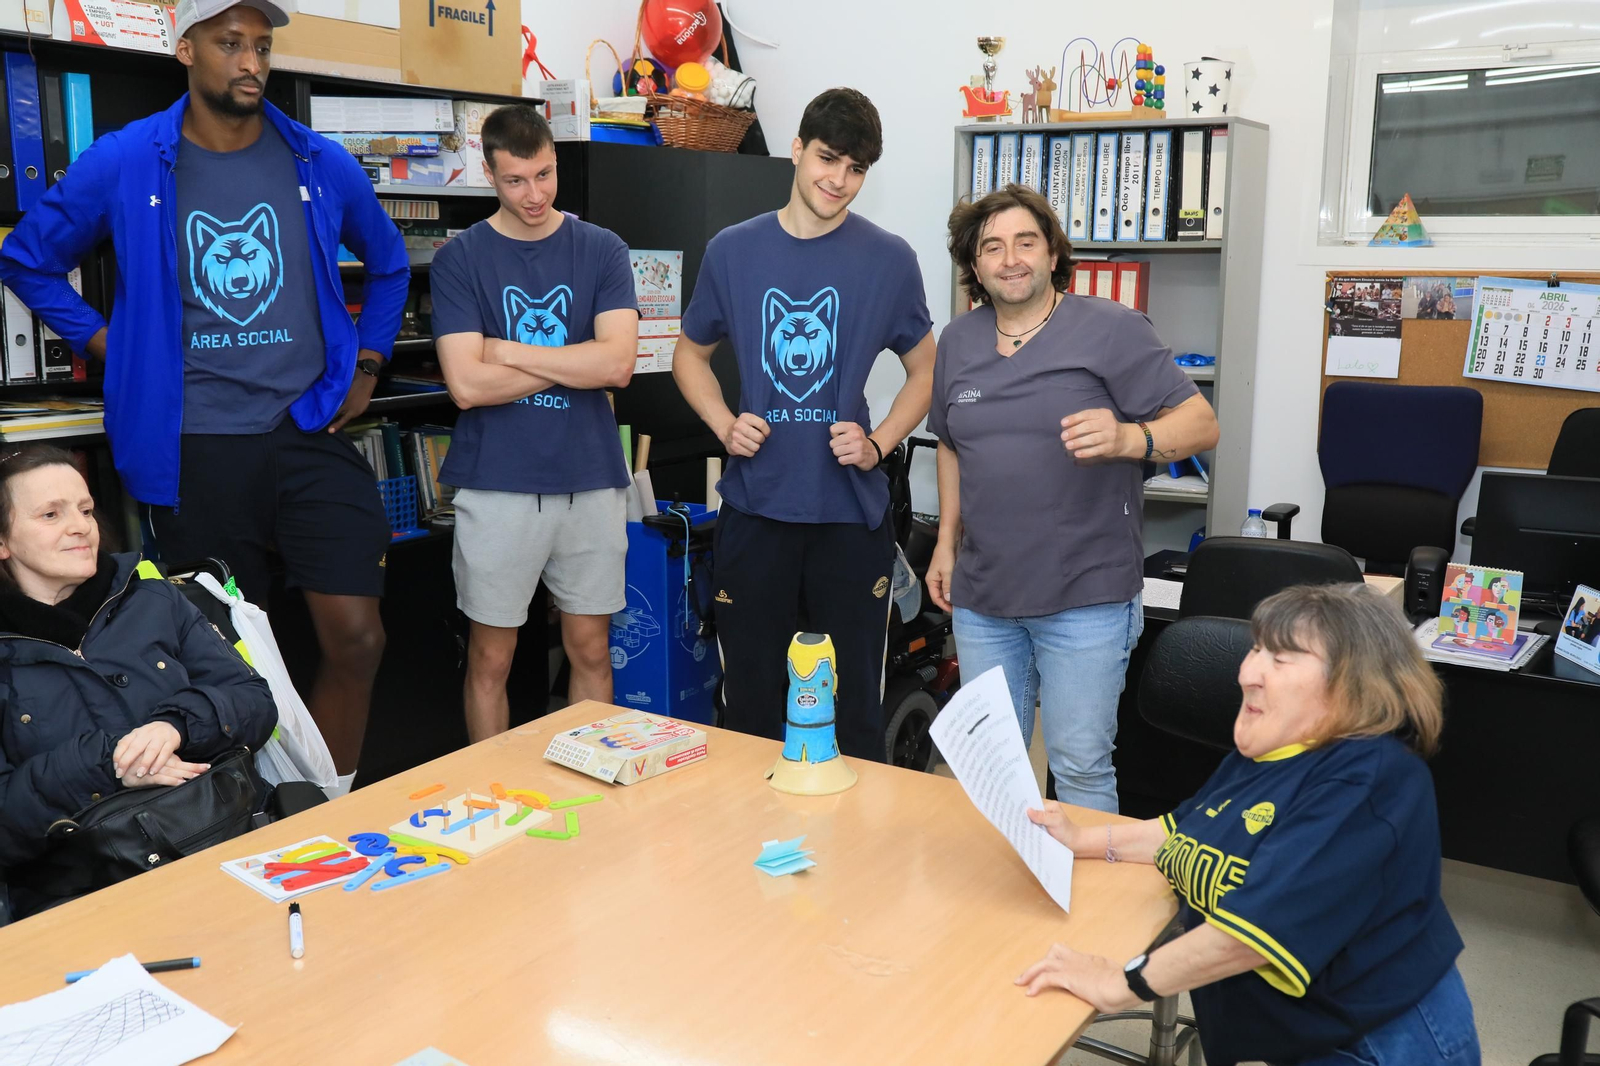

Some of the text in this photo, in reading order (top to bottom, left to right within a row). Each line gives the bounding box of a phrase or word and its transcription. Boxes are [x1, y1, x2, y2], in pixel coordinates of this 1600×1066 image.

[438, 6, 486, 24] FRAGILE
[676, 19, 700, 45] acciona
[1052, 143, 1062, 211] VOLUNTARIADO
[1540, 292, 1569, 302] ABRIL
[1542, 301, 1565, 311] 2026
[1526, 314, 1530, 324] 1
[1545, 316, 1551, 326] 2
[1566, 317, 1571, 328] 3
[1586, 320, 1592, 330] 4
[191, 328, 293, 349] ÁREA SOCIAL
[1484, 323, 1591, 344] 6 7 8 9 10 11
[1480, 335, 1589, 357] 13 14 15 16 17 18
[1477, 349, 1487, 359] 20
[1496, 351, 1506, 361] 21
[1516, 353, 1526, 364] 22
[1536, 355, 1546, 366] 23
[1556, 357, 1566, 368] 24
[1576, 359, 1586, 370] 25
[1475, 362, 1544, 379] 27 28 29 30
[765, 408, 838, 423] REA SOCIAL
